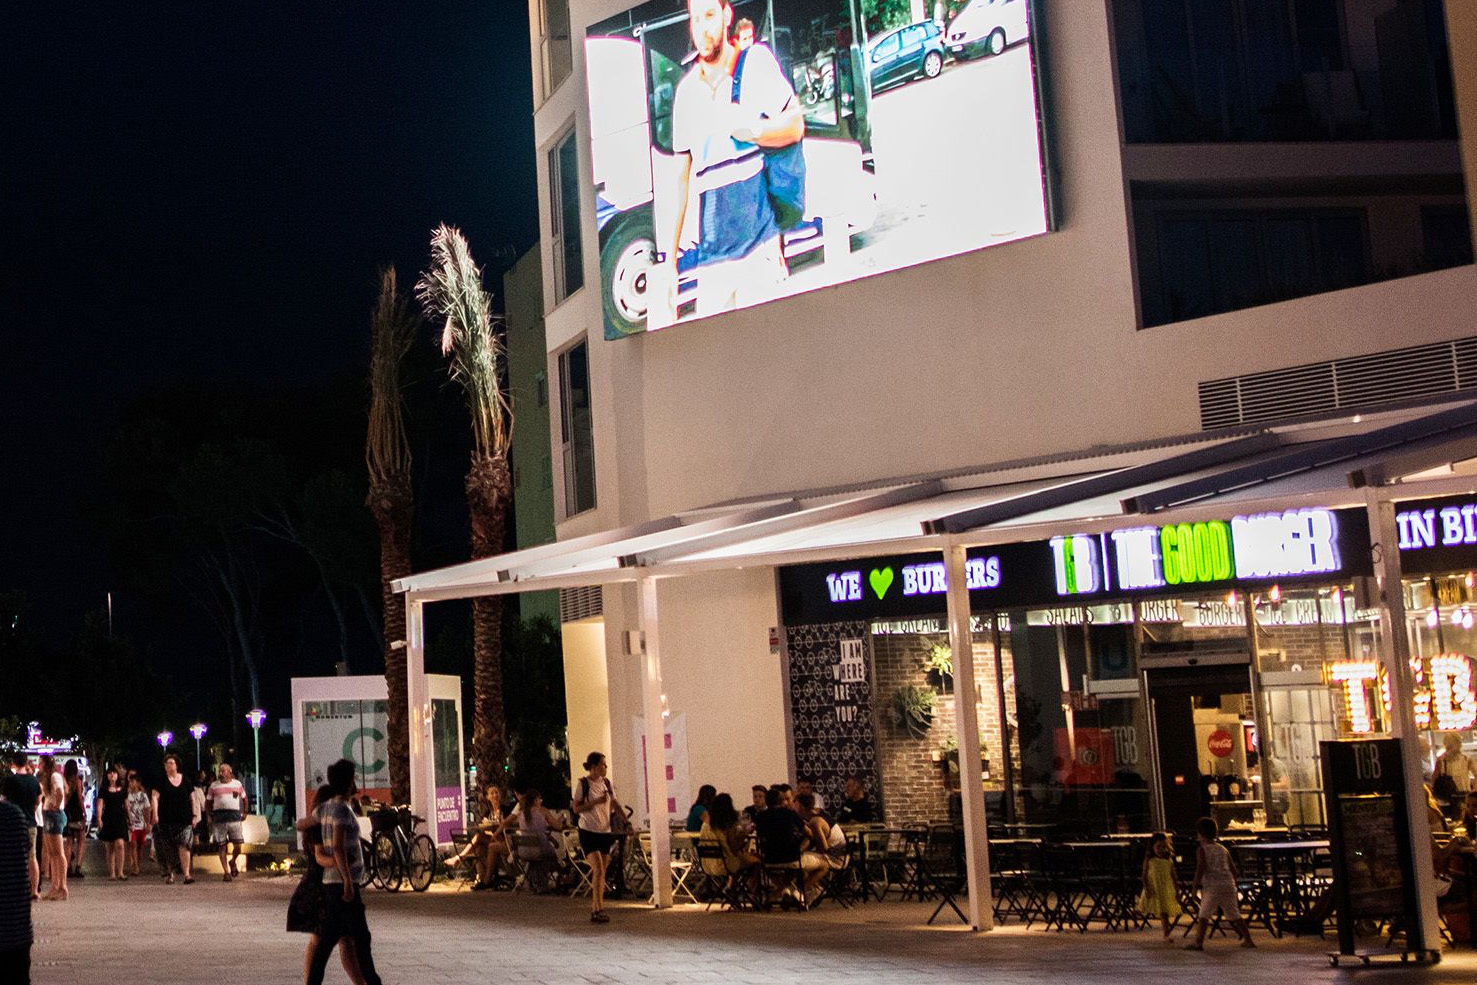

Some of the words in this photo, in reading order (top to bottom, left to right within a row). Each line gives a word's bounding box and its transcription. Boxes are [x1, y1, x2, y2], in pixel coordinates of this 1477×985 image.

[1396, 509, 1436, 548] IN
[1440, 503, 1477, 545] BI
[1049, 534, 1097, 595] TGB
[1111, 526, 1165, 589] THE
[1161, 519, 1235, 585] GOOD
[1230, 507, 1342, 578] BURGER
[826, 571, 862, 603] WE
[902, 556, 1000, 595] BURERS
[1140, 601, 1180, 622] URGER
[850, 642, 861, 659] AM
[834, 684, 850, 701] ARE
[835, 705, 858, 722] YOU?
[1111, 726, 1139, 765] TGB
[1352, 744, 1382, 780] TGB
